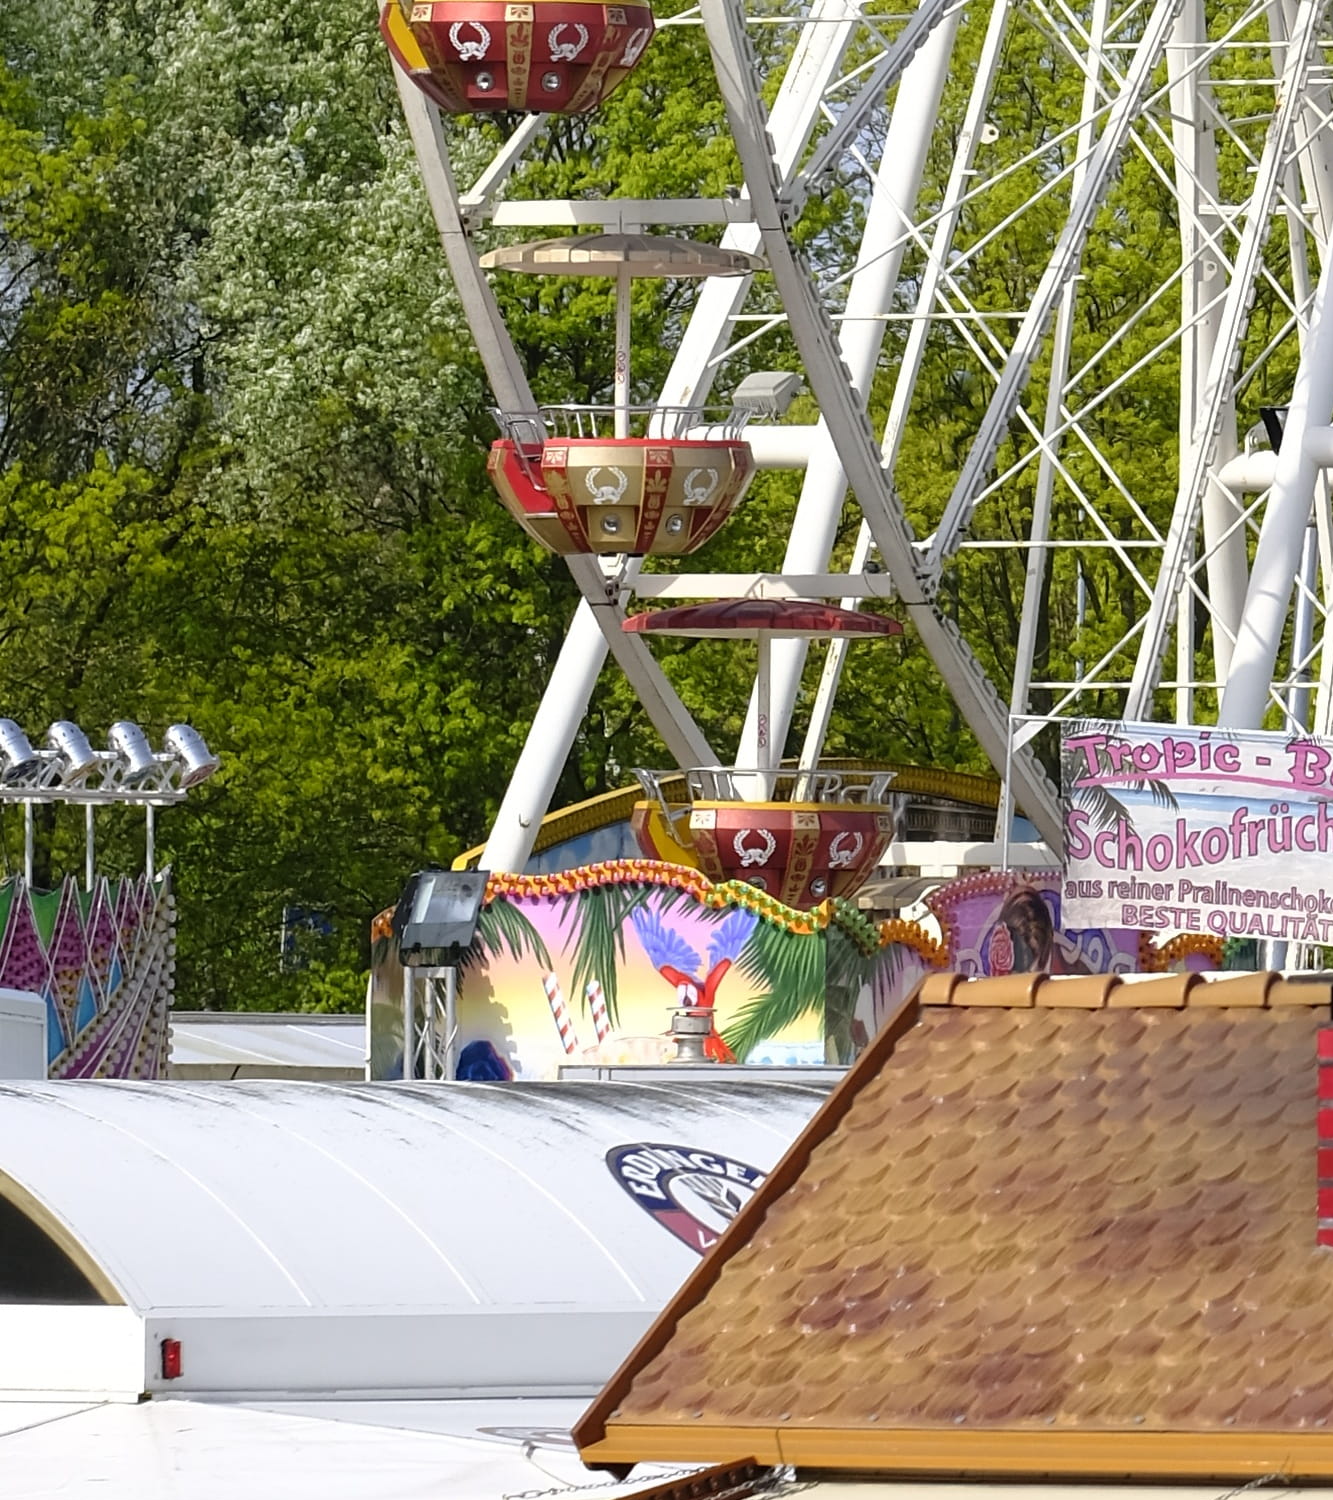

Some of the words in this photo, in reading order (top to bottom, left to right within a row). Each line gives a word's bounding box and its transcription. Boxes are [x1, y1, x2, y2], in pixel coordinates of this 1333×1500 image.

[1064, 732, 1241, 776] Tropic
[1064, 879, 1103, 899] aus
[1107, 876, 1174, 902] reiner
[1121, 905, 1201, 931] BESTE
